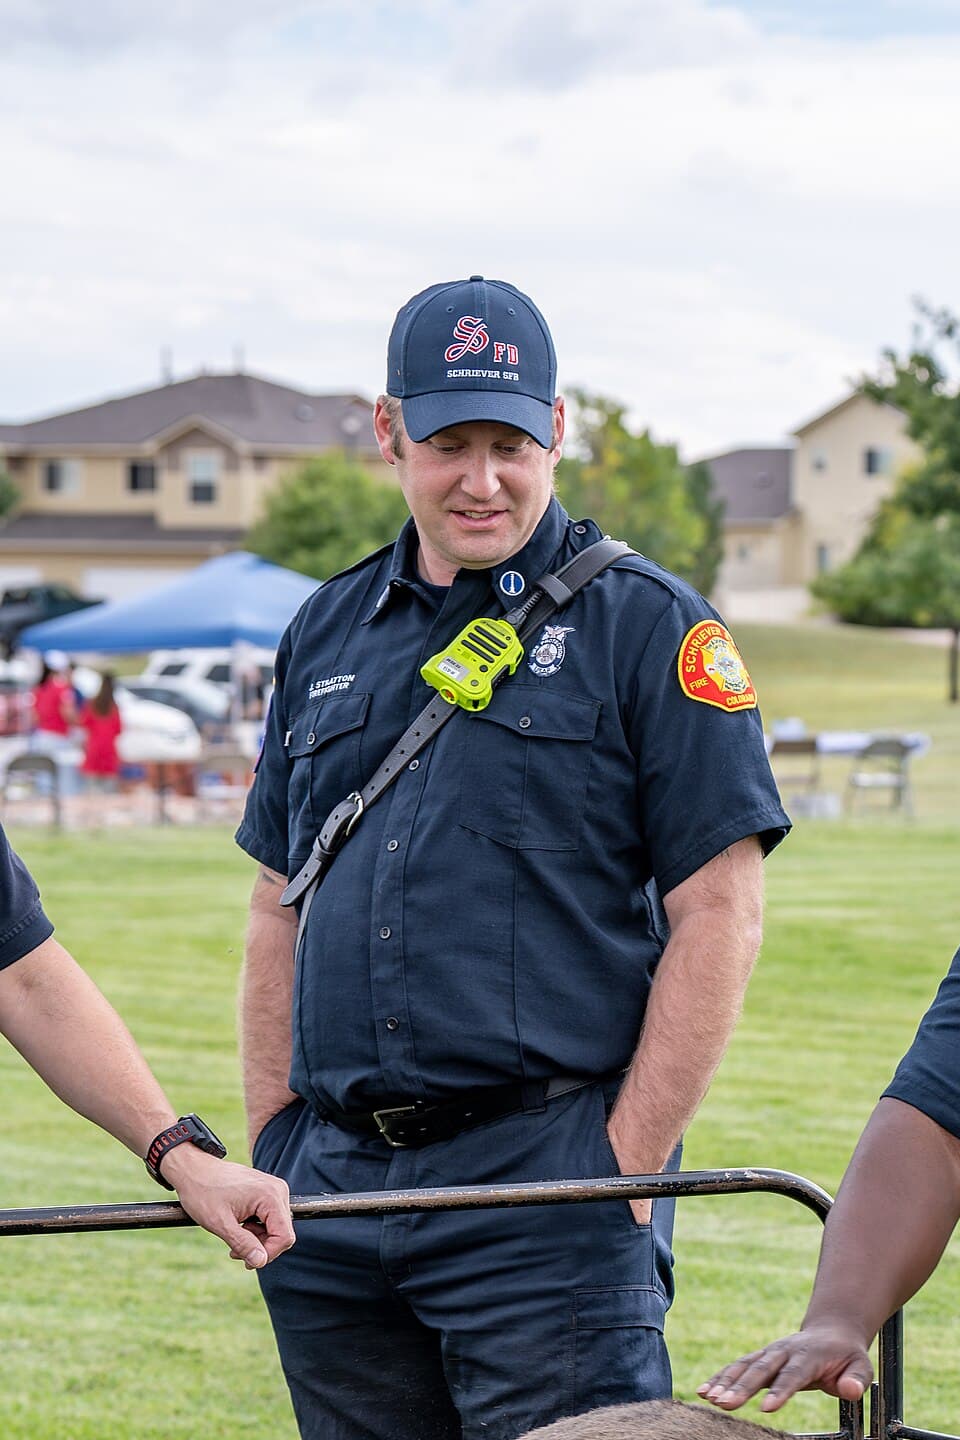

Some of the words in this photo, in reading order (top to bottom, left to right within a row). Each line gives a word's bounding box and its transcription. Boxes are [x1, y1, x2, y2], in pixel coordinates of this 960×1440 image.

[493, 341, 519, 365] FD
[446, 368, 501, 379] SCHRIEVER
[502, 371, 520, 381] SFB
[315, 674, 356, 689] STRATTON
[689, 676, 709, 692] FIRE
[308, 682, 350, 700] FIREFIGHTER
